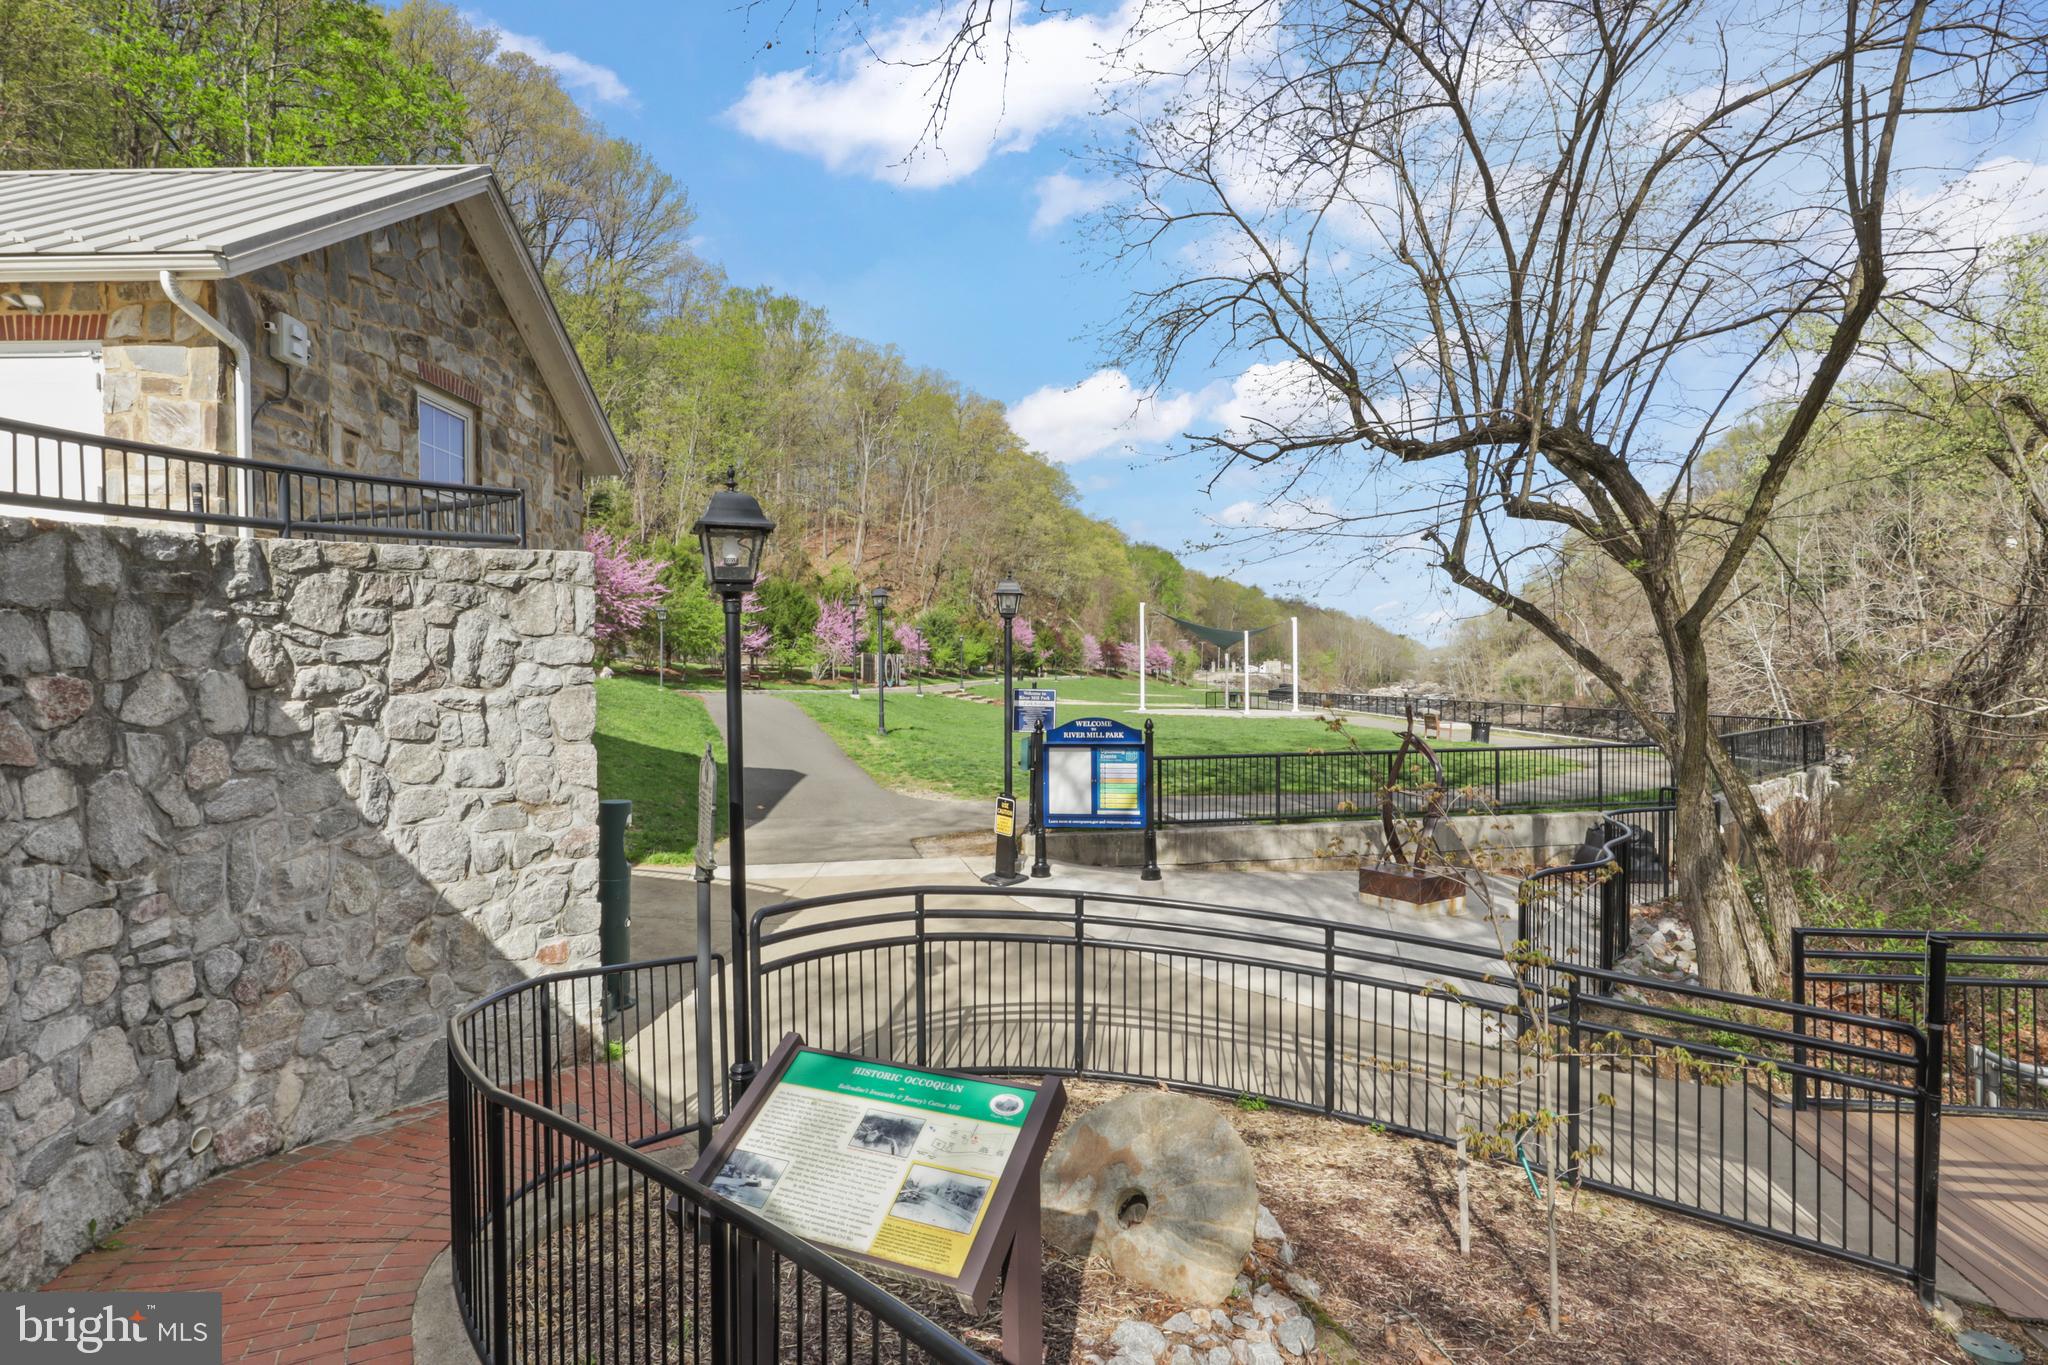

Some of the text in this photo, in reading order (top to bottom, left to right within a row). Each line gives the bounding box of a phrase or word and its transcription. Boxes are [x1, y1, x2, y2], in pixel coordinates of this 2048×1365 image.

[1063, 731, 1124, 739] RIVER MILL PARK
[852, 1066, 965, 1094] HISTORIC OCCOQUAN
